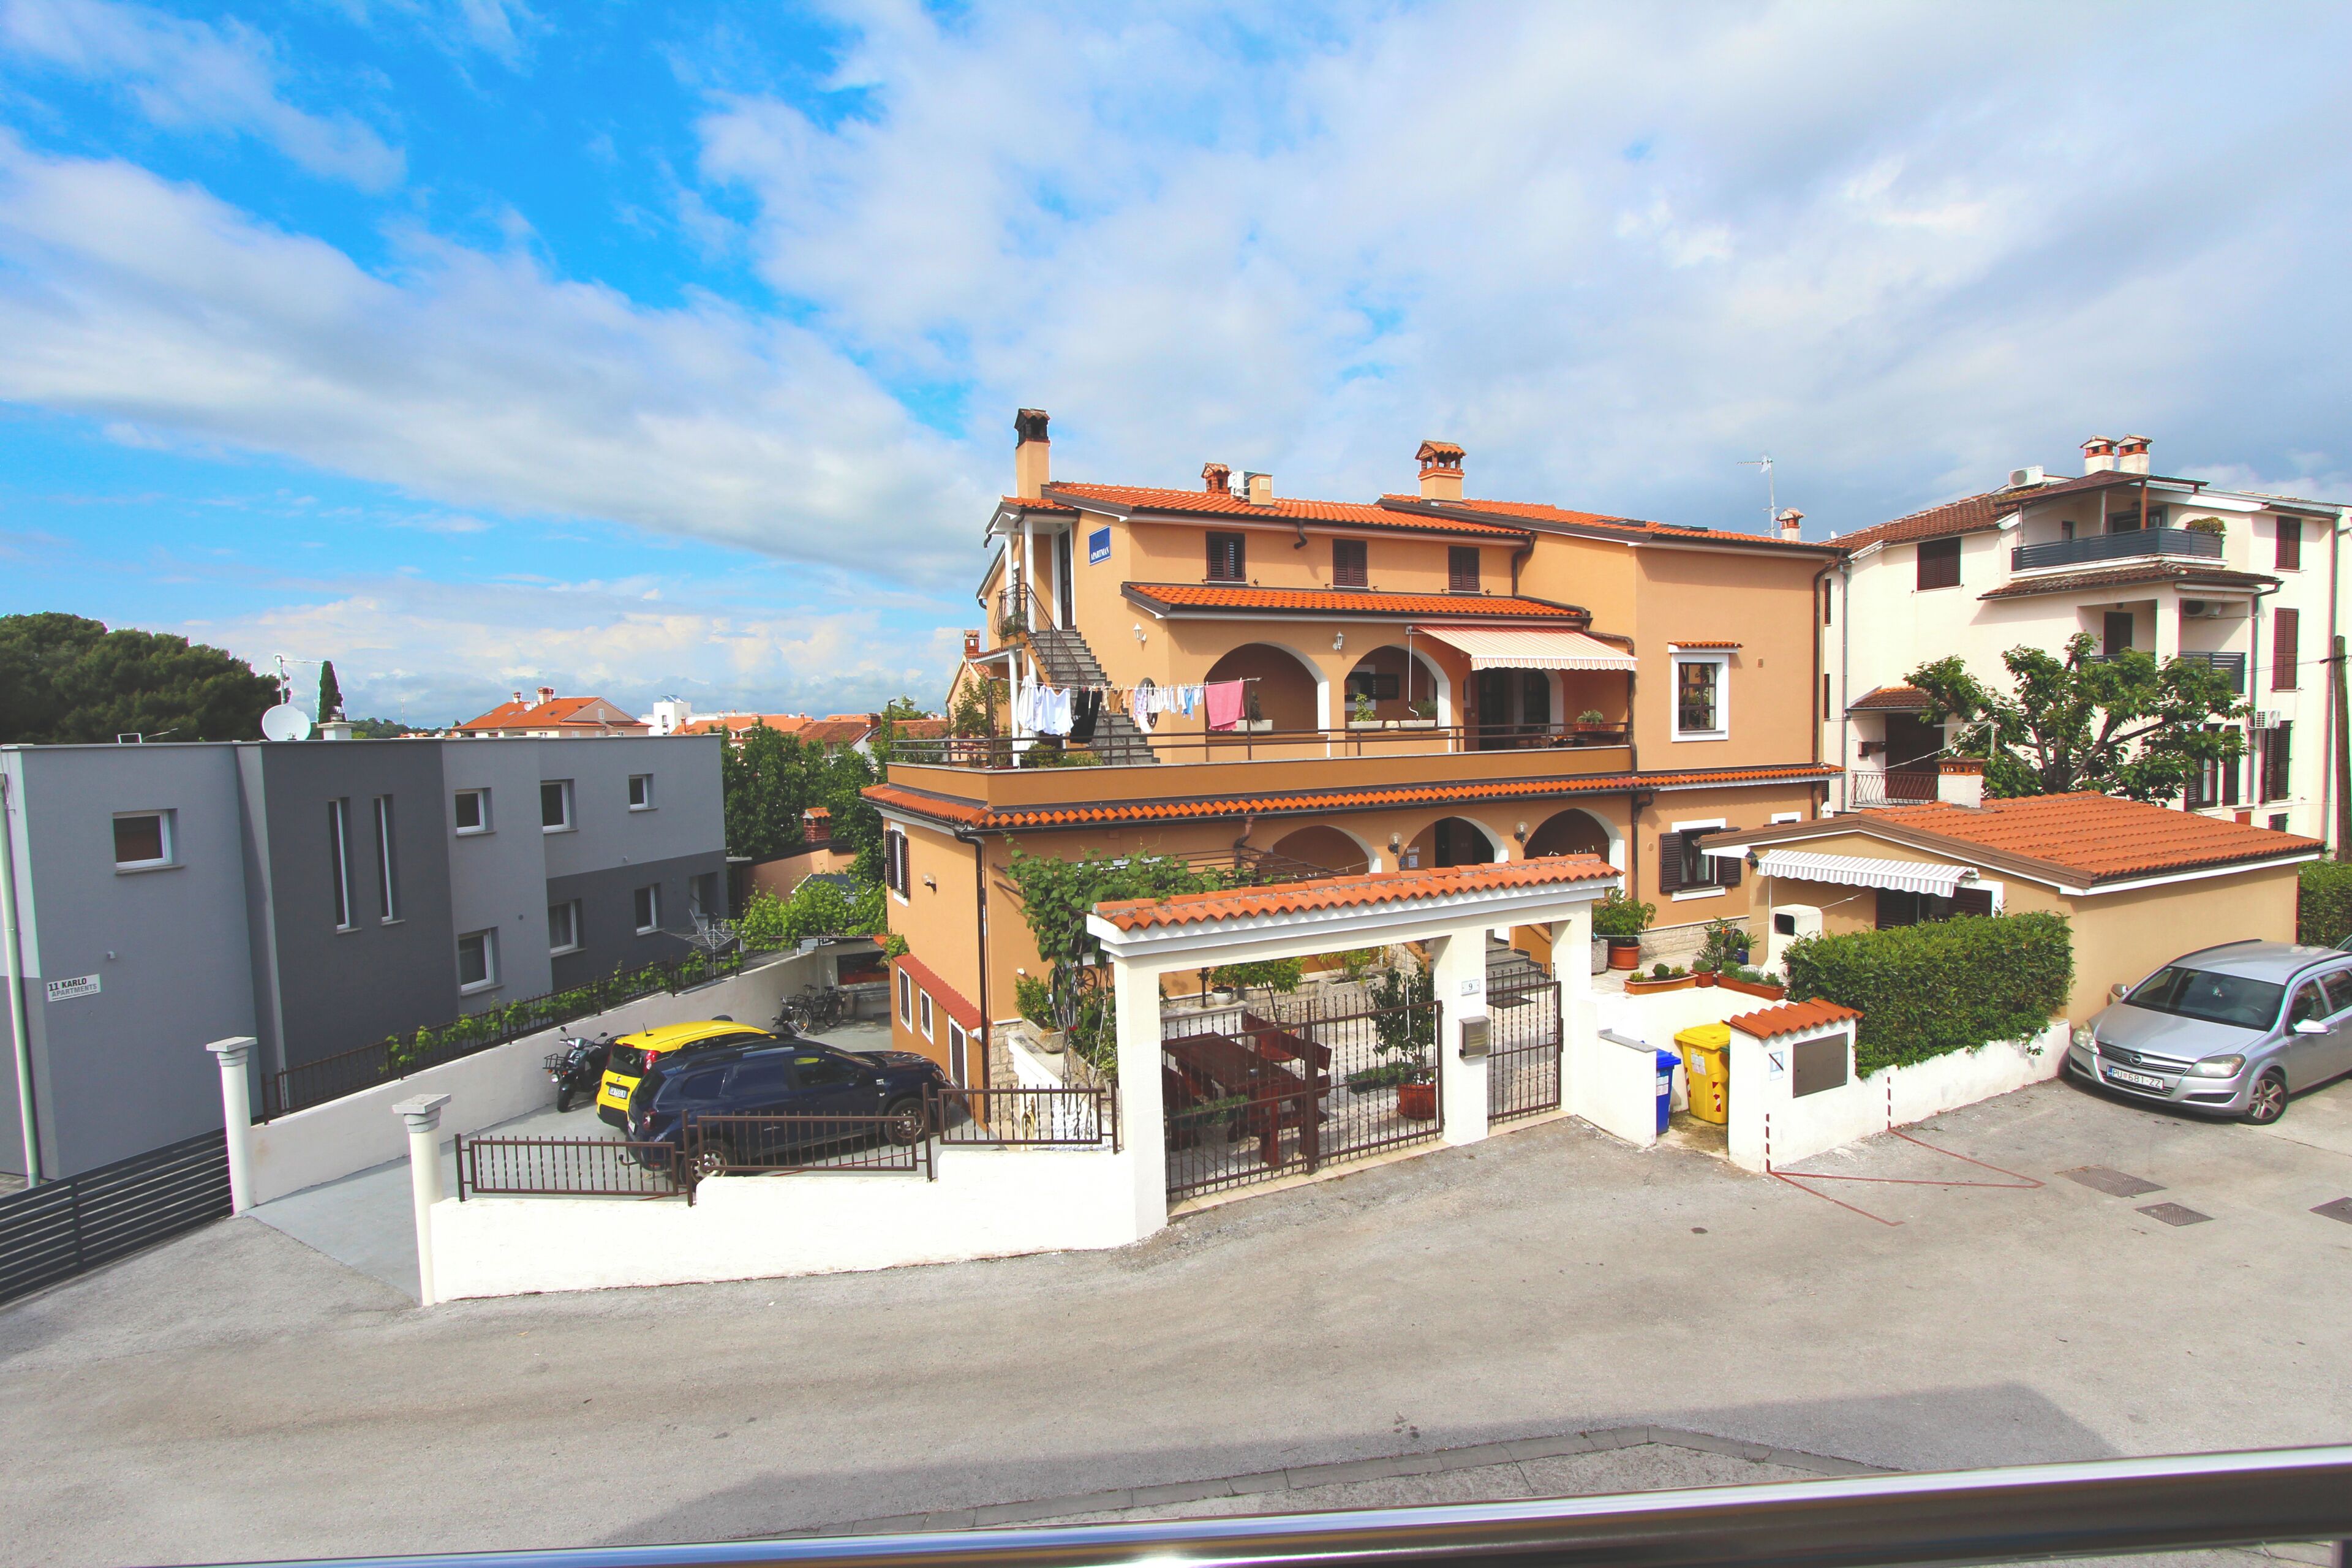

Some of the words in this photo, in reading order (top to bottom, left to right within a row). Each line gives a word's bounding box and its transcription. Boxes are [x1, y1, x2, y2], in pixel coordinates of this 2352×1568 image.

[1090, 546, 1109, 560] APARTMAN
[48, 982, 59, 992] 11
[62, 978, 87, 989] KARLO
[52, 984, 97, 998] APARTMENTS
[1468, 982, 1473, 991] 9
[2113, 1069, 2122, 1078] PU
